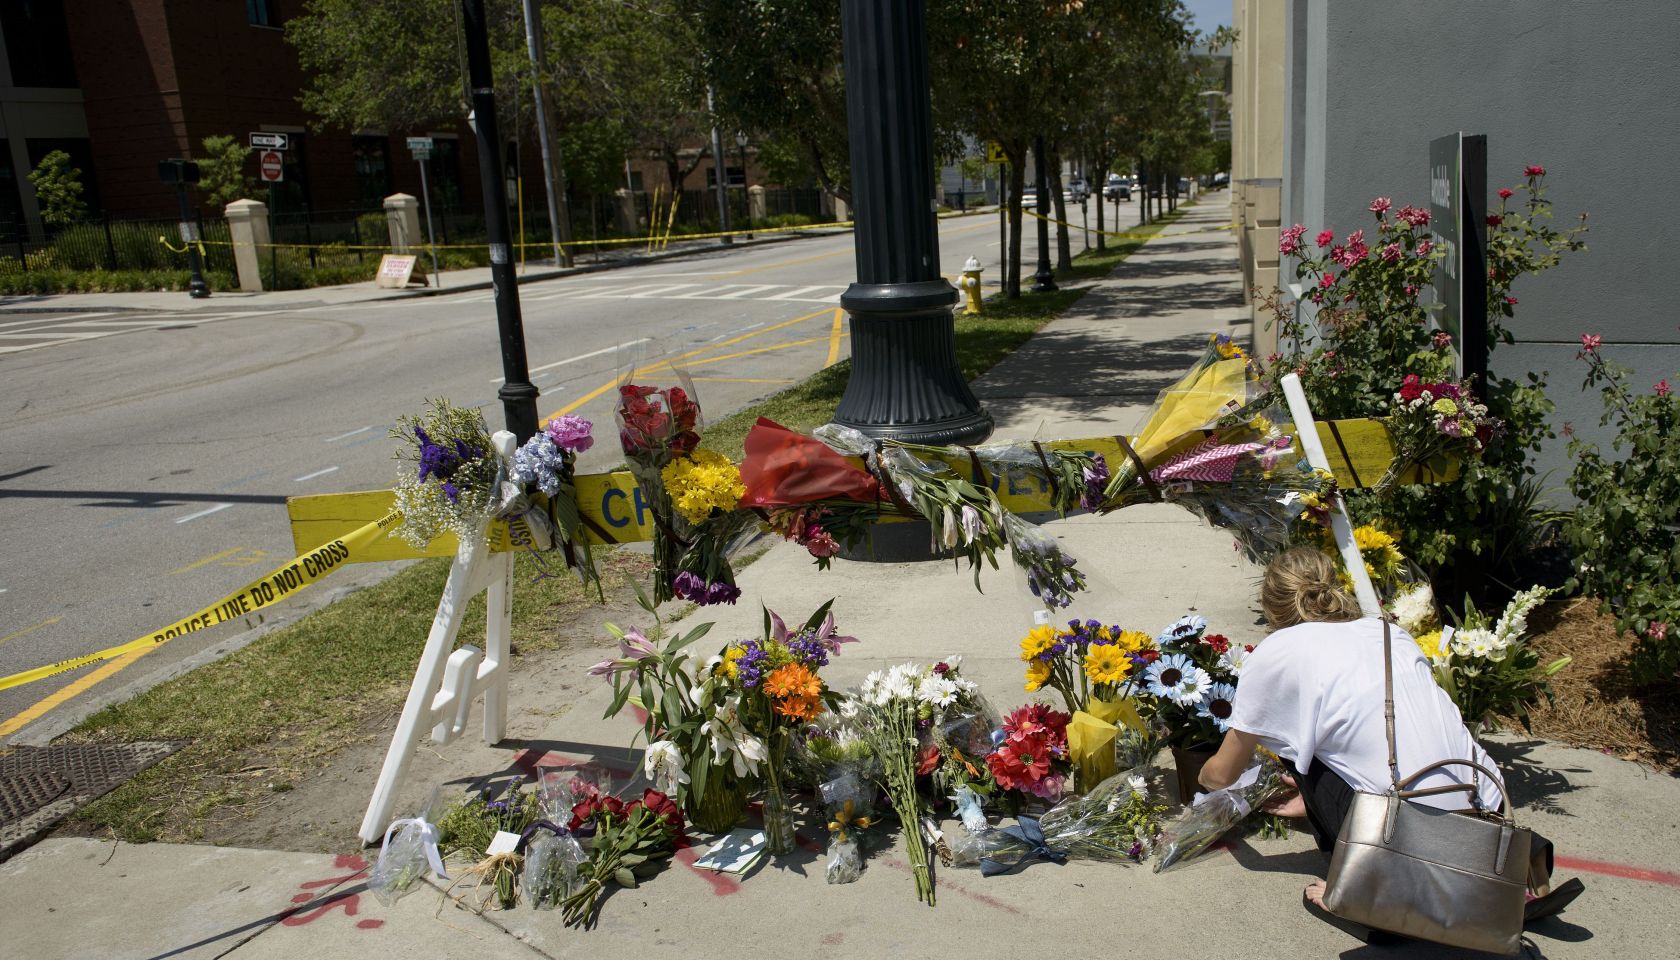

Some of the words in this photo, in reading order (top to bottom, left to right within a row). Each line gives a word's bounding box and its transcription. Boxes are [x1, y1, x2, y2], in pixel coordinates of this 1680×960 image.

[378, 513, 397, 528] POLICE
[153, 613, 211, 642] POLICE
[215, 594, 251, 622] LINE
[251, 582, 274, 607] DO
[273, 564, 304, 595] NOT
[302, 540, 349, 578] CROSS
